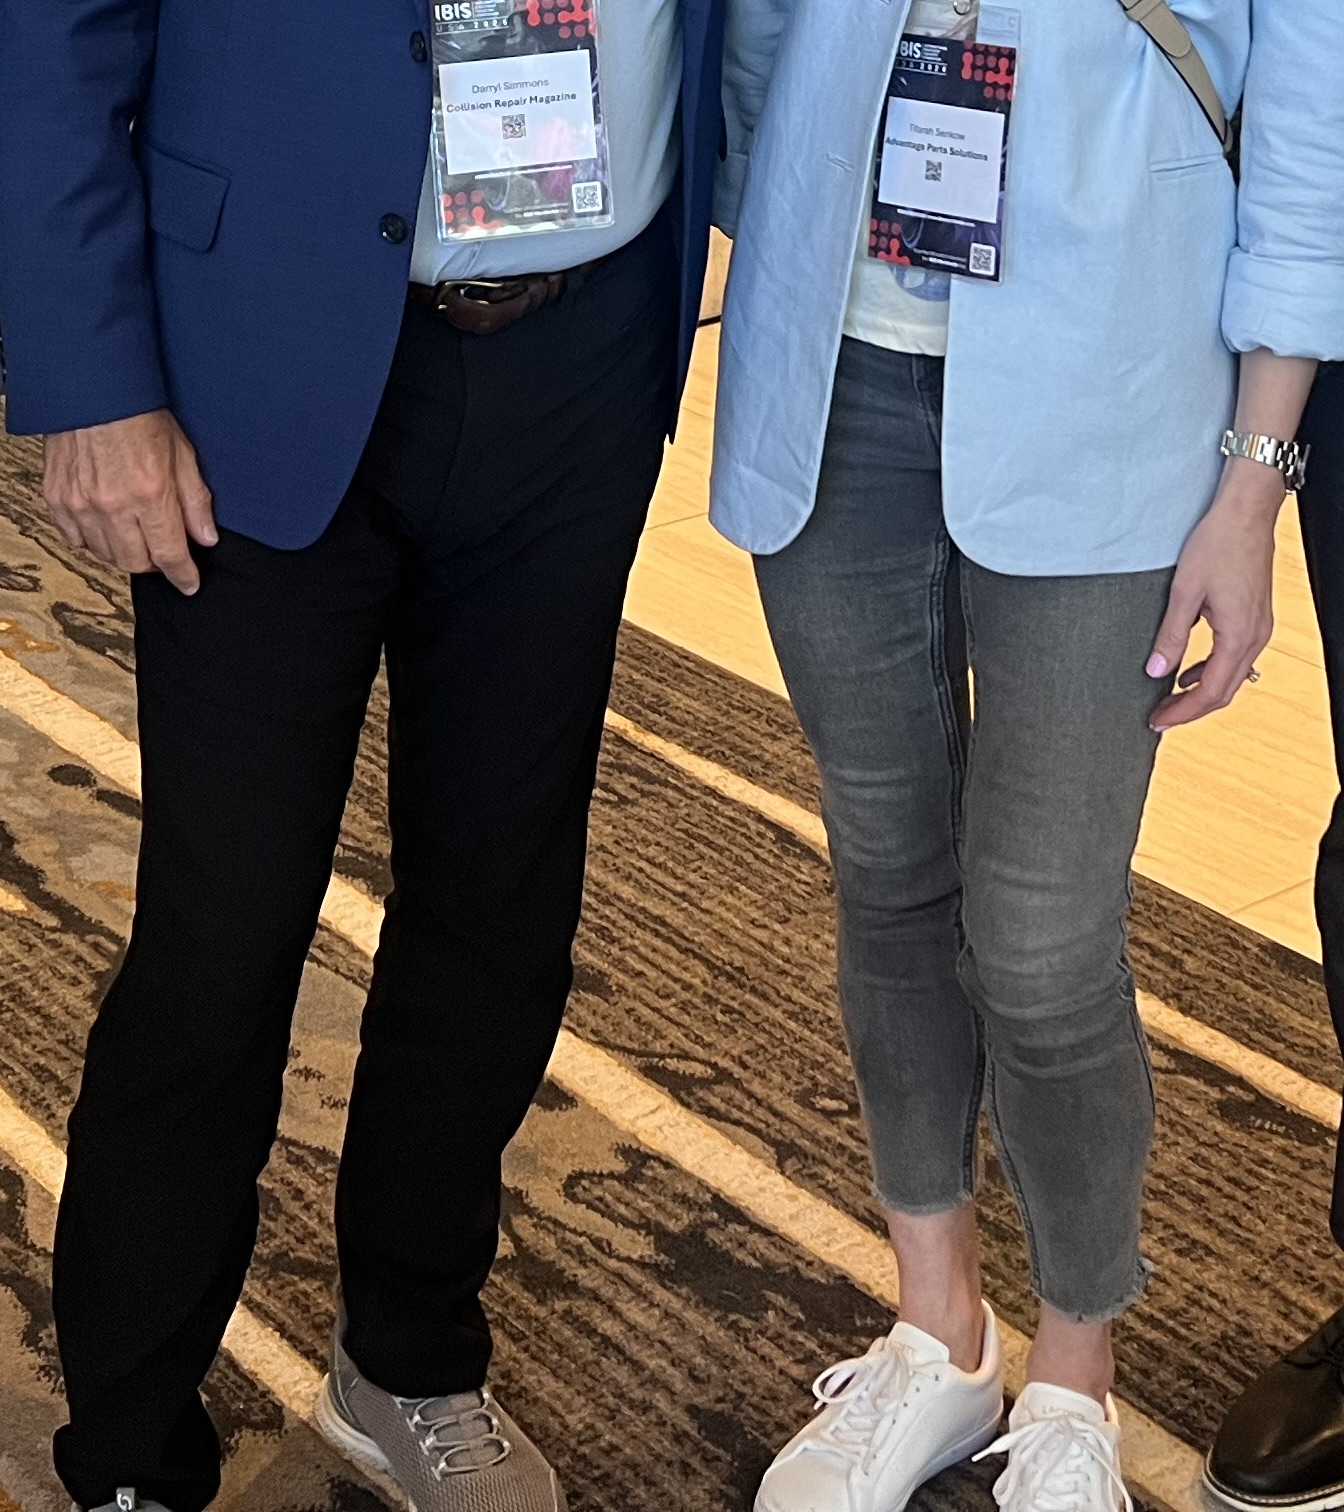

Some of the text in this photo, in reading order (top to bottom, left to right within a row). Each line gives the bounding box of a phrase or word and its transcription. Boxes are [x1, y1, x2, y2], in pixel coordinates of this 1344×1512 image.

[434, 1, 472, 21] IBIS
[436, 23, 465, 33] USA
[899, 40, 922, 59] BIS
[471, 78, 550, 94] Darryl Simmons
[446, 92, 577, 113] Collision Repair Magazine
[926, 142, 948, 155] Parts
[949, 146, 988, 162] Solutions
